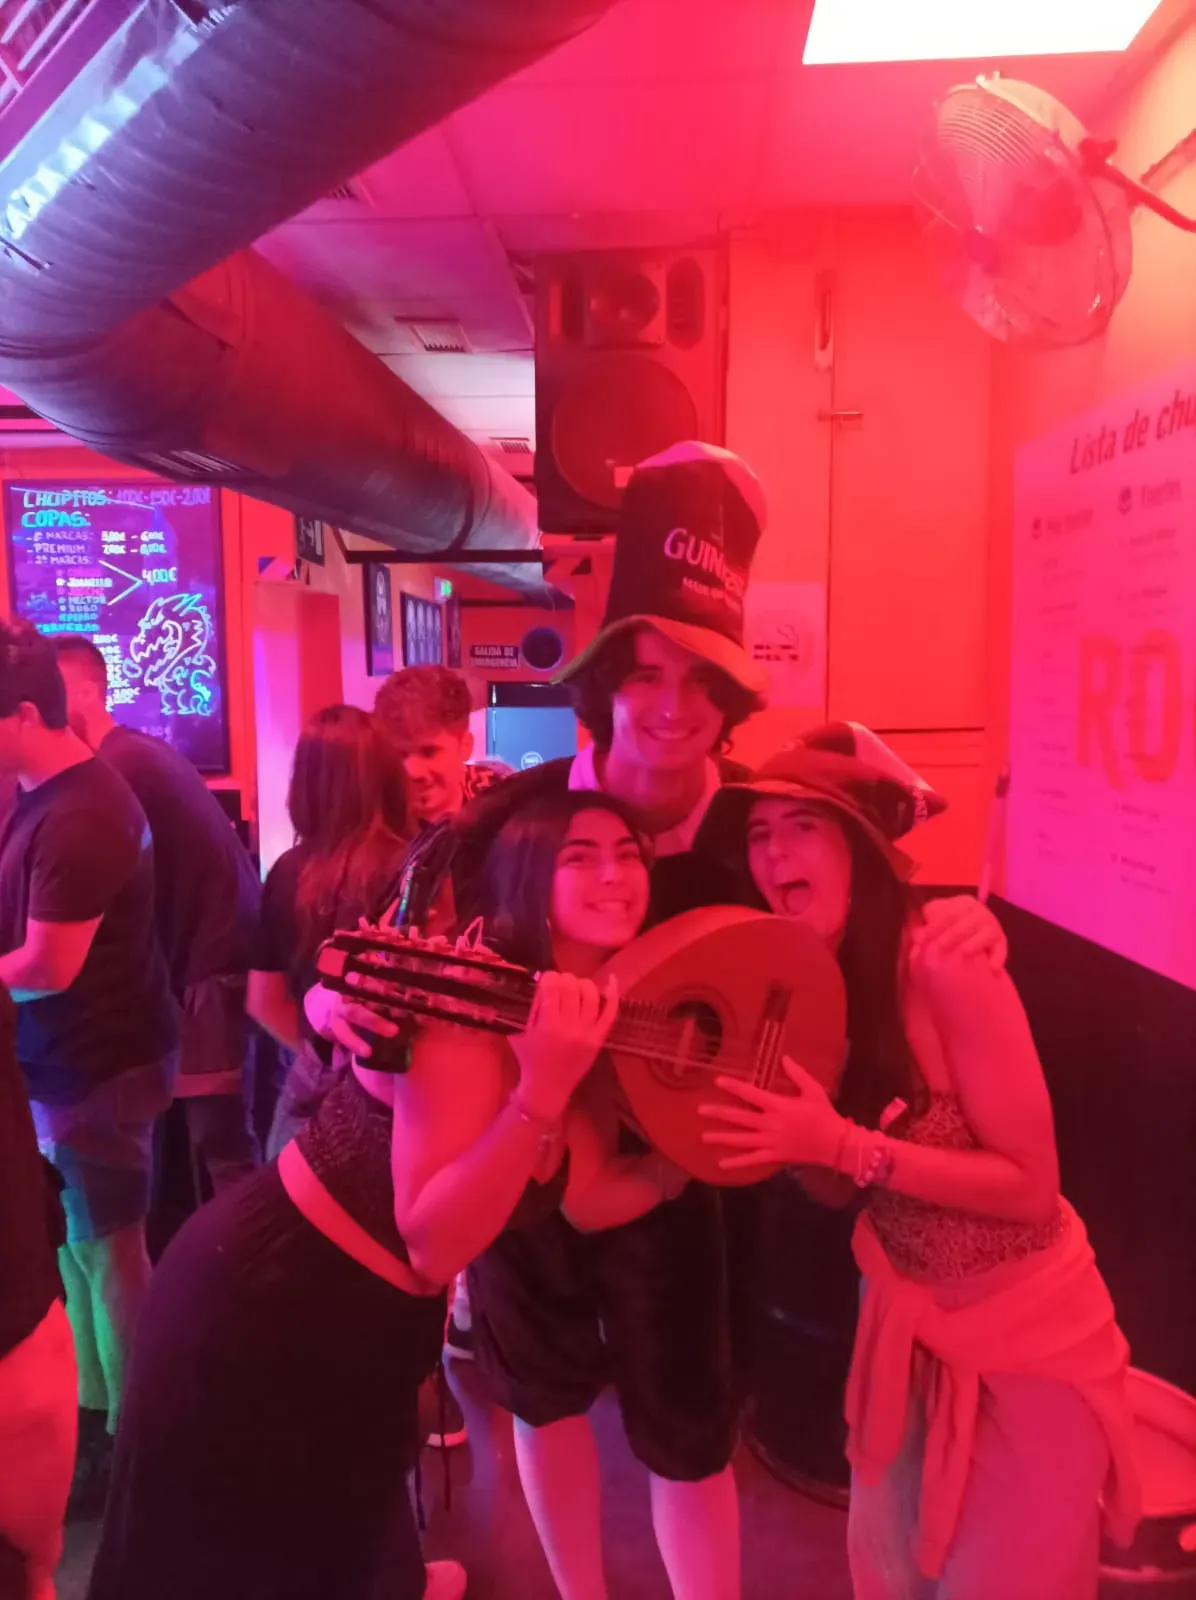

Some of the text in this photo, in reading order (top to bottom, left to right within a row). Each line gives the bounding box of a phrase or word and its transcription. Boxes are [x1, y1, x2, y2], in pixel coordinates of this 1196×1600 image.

[1069, 388, 1196, 474] Lista de chu
[21, 509, 91, 528] COPAS:
[1076, 631, 1196, 792] RO
